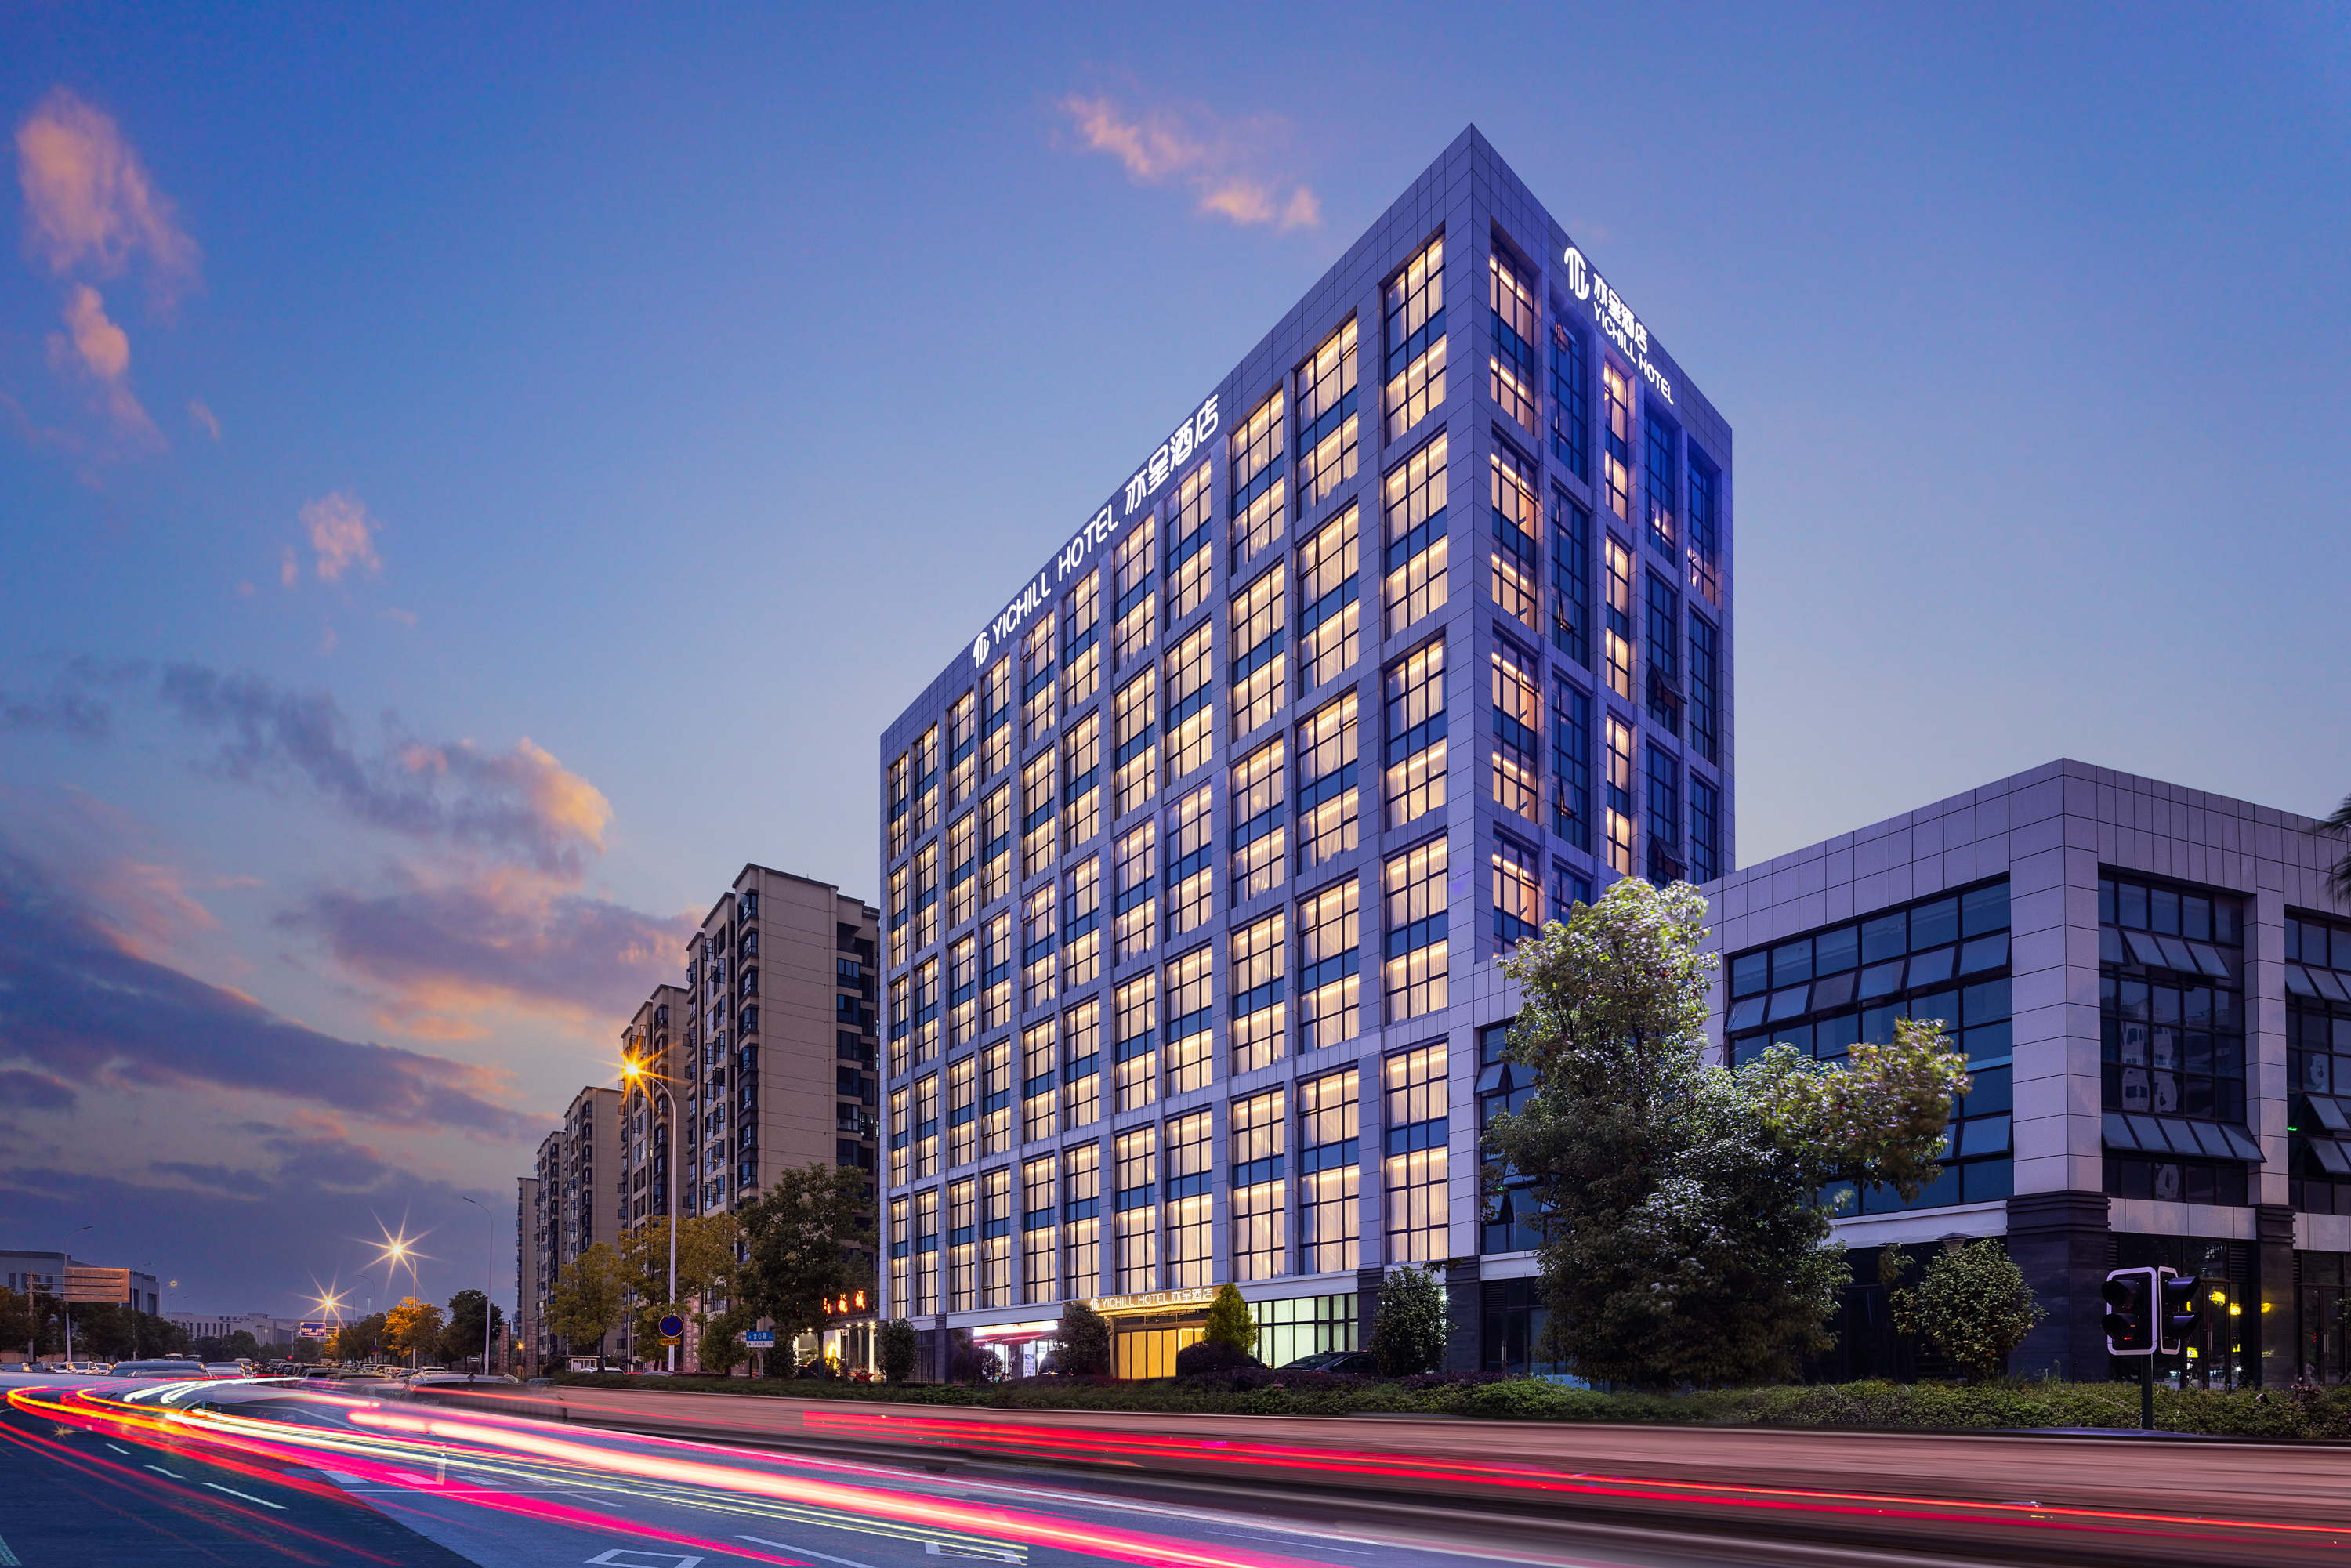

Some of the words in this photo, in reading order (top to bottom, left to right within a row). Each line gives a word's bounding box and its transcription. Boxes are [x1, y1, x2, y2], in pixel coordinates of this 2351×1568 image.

[1593, 273, 1648, 354] 亦呈酒店
[1593, 301, 1637, 364] YICHILL
[1639, 353, 1674, 405] HOTEL
[992, 572, 1052, 645] YICHILL
[1058, 504, 1119, 582] HOTEL
[1125, 394, 1219, 516] 亦呈酒店
[1101, 1296, 1134, 1309] YICHILL
[1138, 1293, 1168, 1305] HOTEL
[1172, 1287, 1213, 1302] 亦呈酒店
